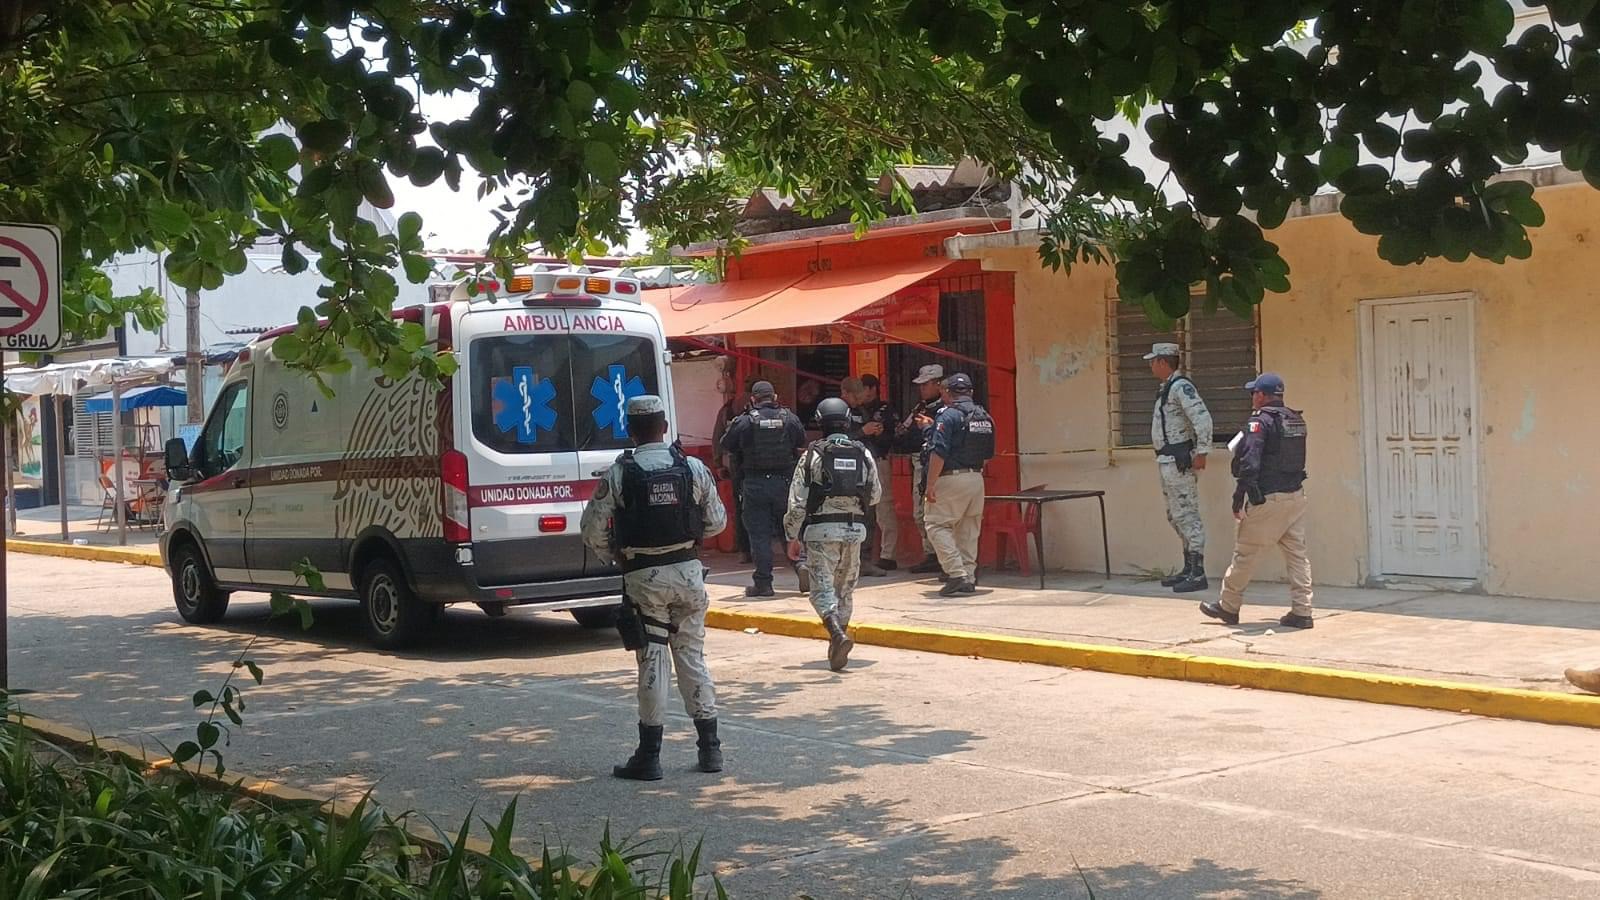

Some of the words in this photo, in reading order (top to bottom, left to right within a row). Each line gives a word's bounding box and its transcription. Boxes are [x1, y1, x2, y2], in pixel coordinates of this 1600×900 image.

[503, 315, 626, 331] AMBULANCIA
[7, 334, 49, 347] GRUA
[481, 488, 515, 502] UNIDAD
[517, 486, 552, 500] DONADA
[553, 485, 574, 498] POR:
[652, 483, 674, 493] GUARDIA
[649, 492, 678, 502] NACIONAL
